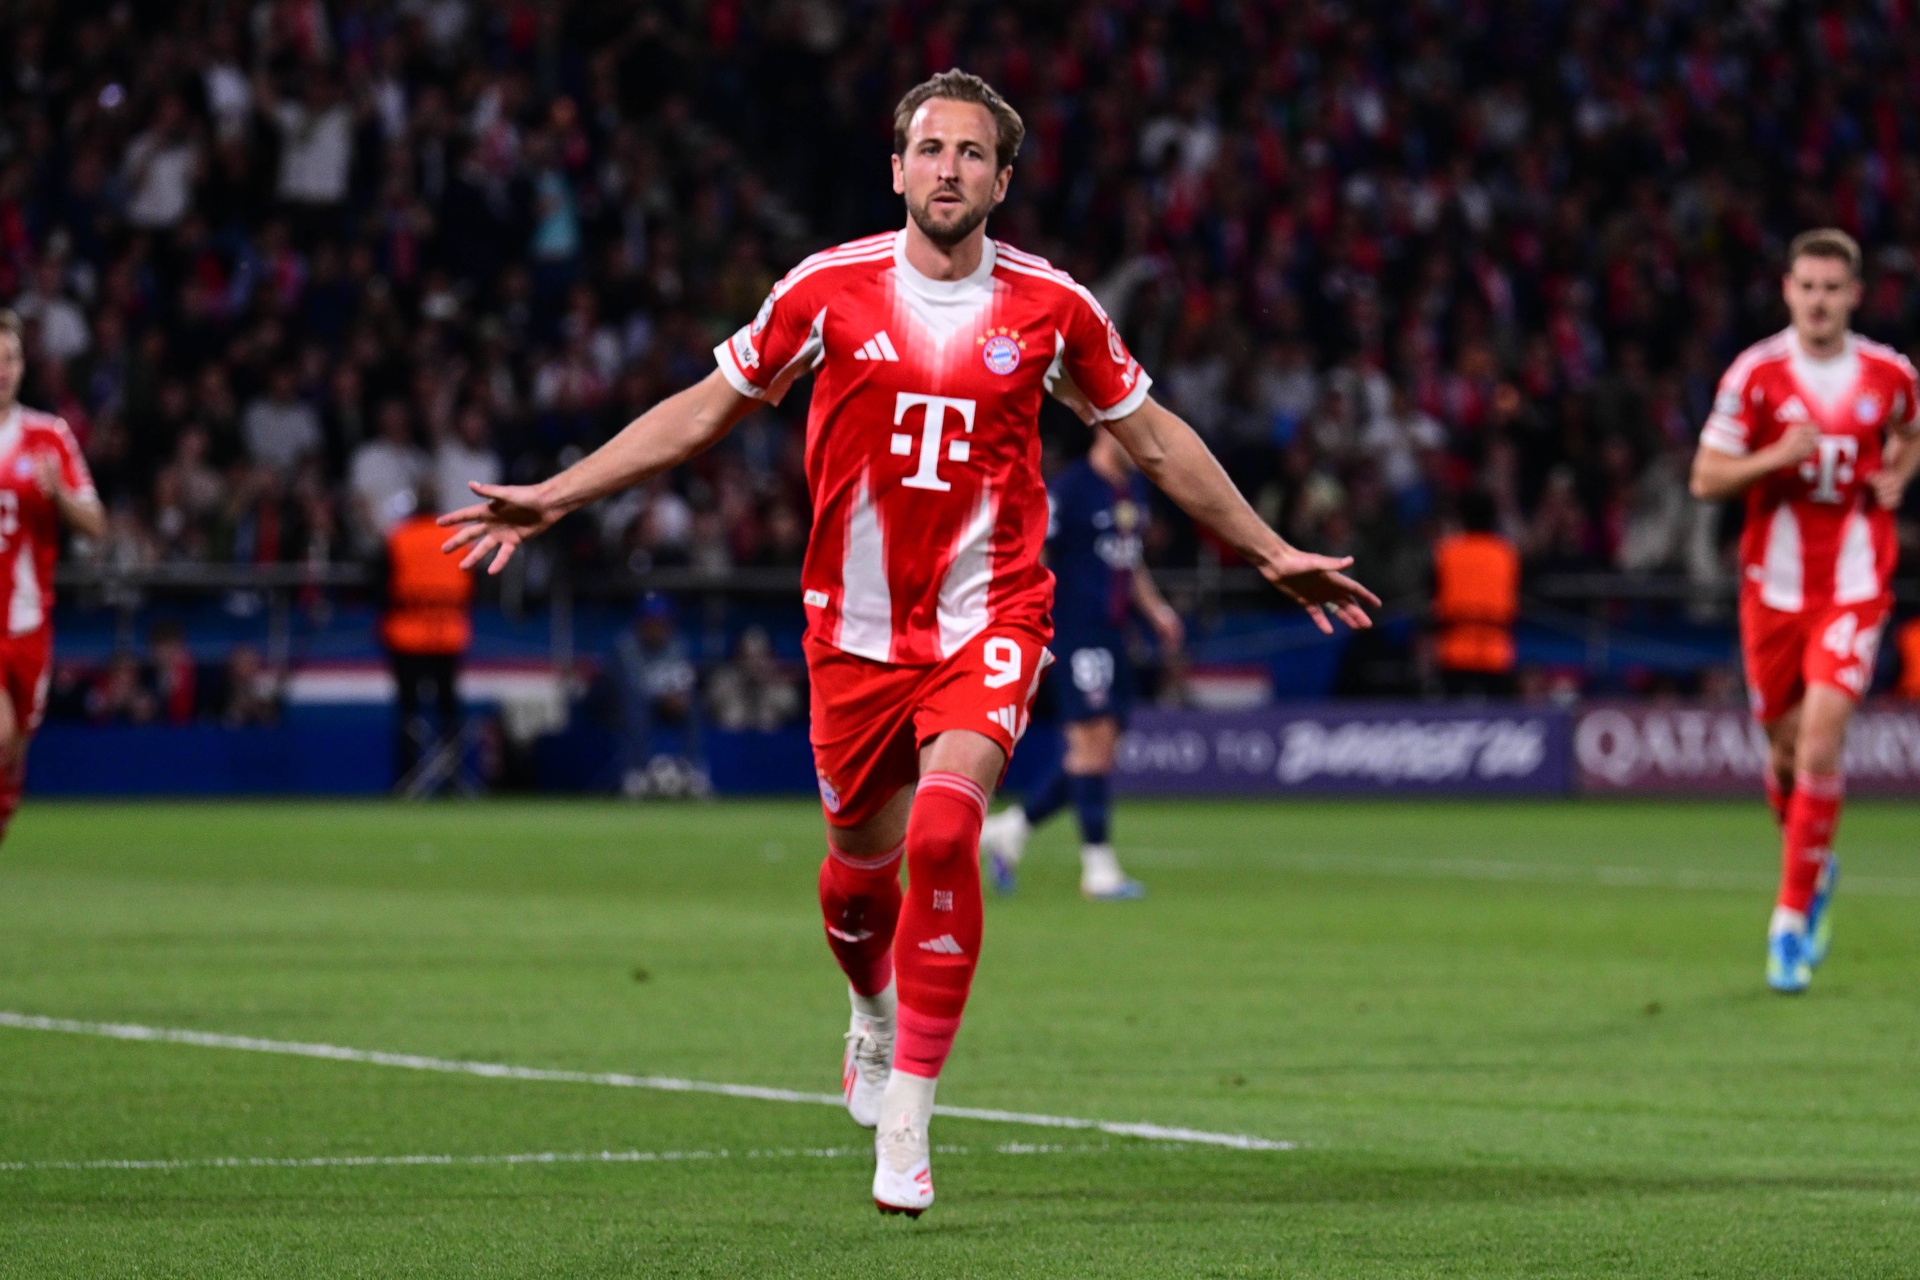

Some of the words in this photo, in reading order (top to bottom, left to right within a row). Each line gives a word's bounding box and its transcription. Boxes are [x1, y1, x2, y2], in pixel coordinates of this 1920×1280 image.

[891, 392, 976, 491] T
[1800, 434, 1859, 505] T
[983, 636, 1022, 689] 9
